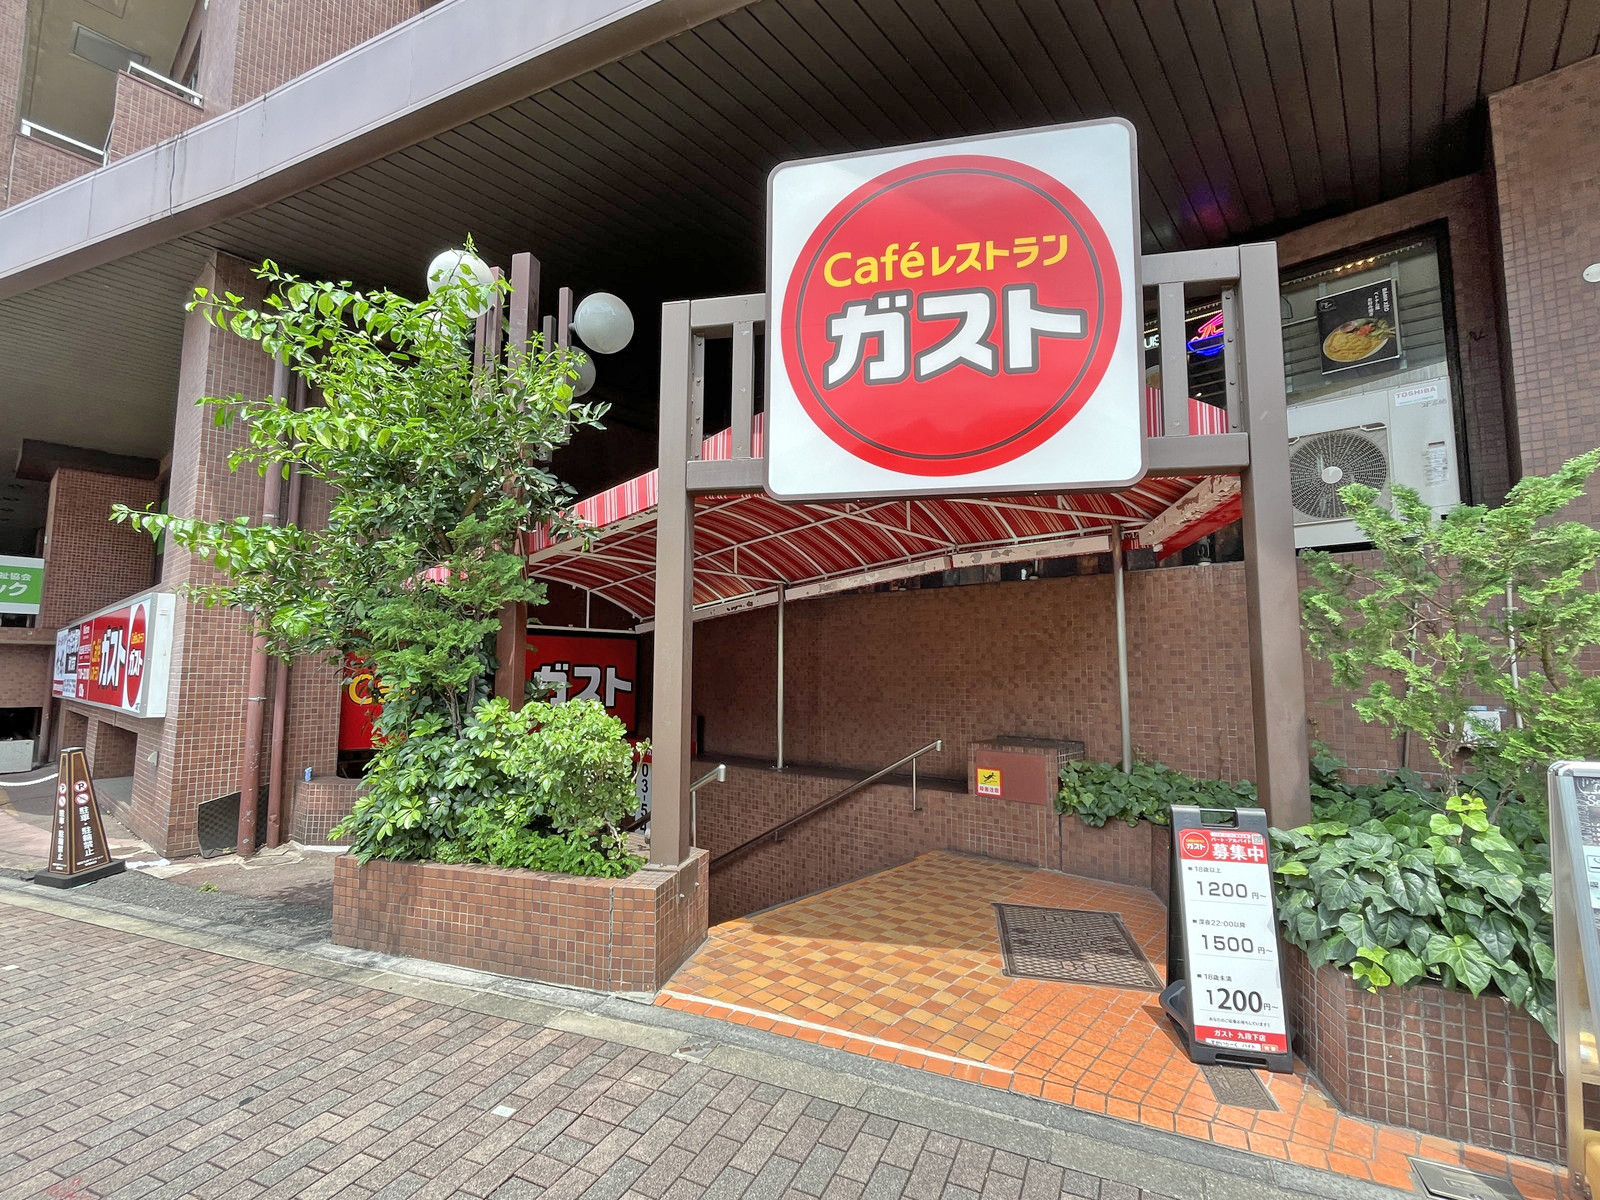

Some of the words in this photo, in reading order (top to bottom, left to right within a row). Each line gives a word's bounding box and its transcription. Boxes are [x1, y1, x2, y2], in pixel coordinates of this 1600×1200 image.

[824, 235, 1068, 287] Caféレストラン
[824, 284, 1086, 389] ガスト
[1396, 386, 1437, 399] TOSHIBA
[98, 625, 127, 689] ガスト
[533, 663, 633, 708] ガスト
[1212, 843, 1264, 862] 募集中
[1213, 1029, 1234, 1038] ガスト
